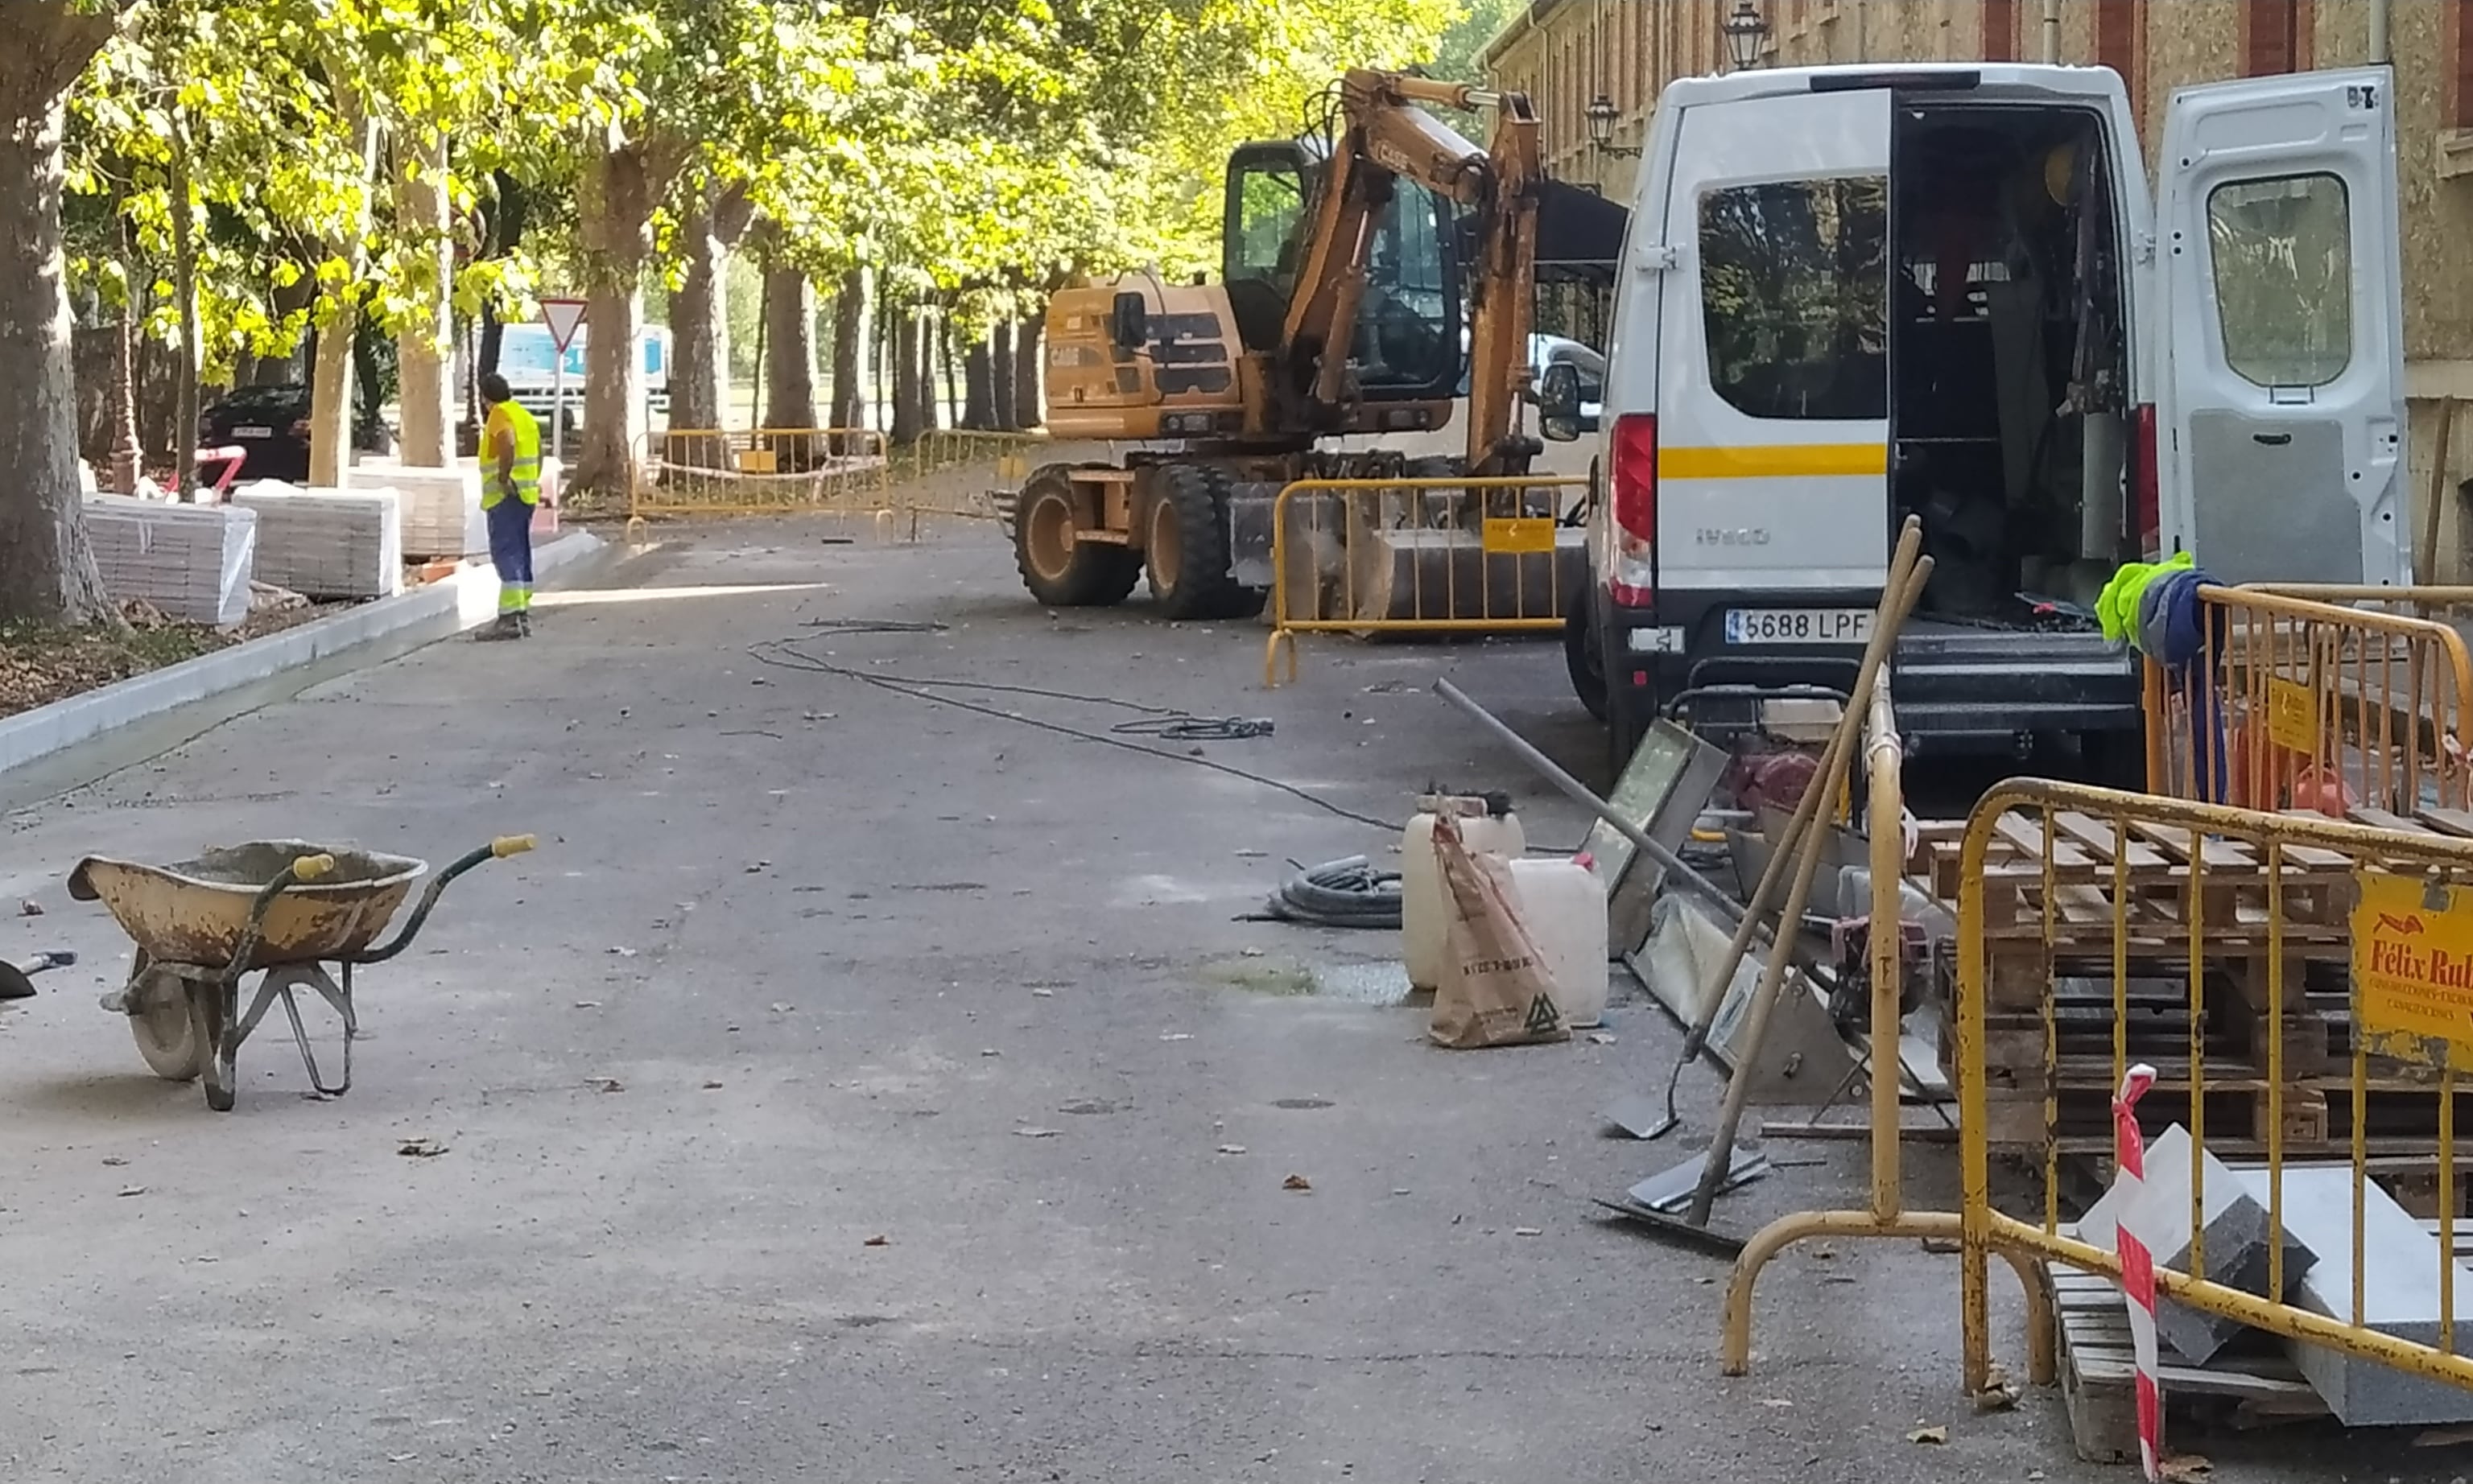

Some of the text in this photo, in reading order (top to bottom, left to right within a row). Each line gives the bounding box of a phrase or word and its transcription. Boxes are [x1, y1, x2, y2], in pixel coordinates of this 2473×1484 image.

[1696, 528, 1770, 546] IVECO
[1746, 613, 1868, 638] 5688 LPF
[2371, 939, 2426, 980] Félix
